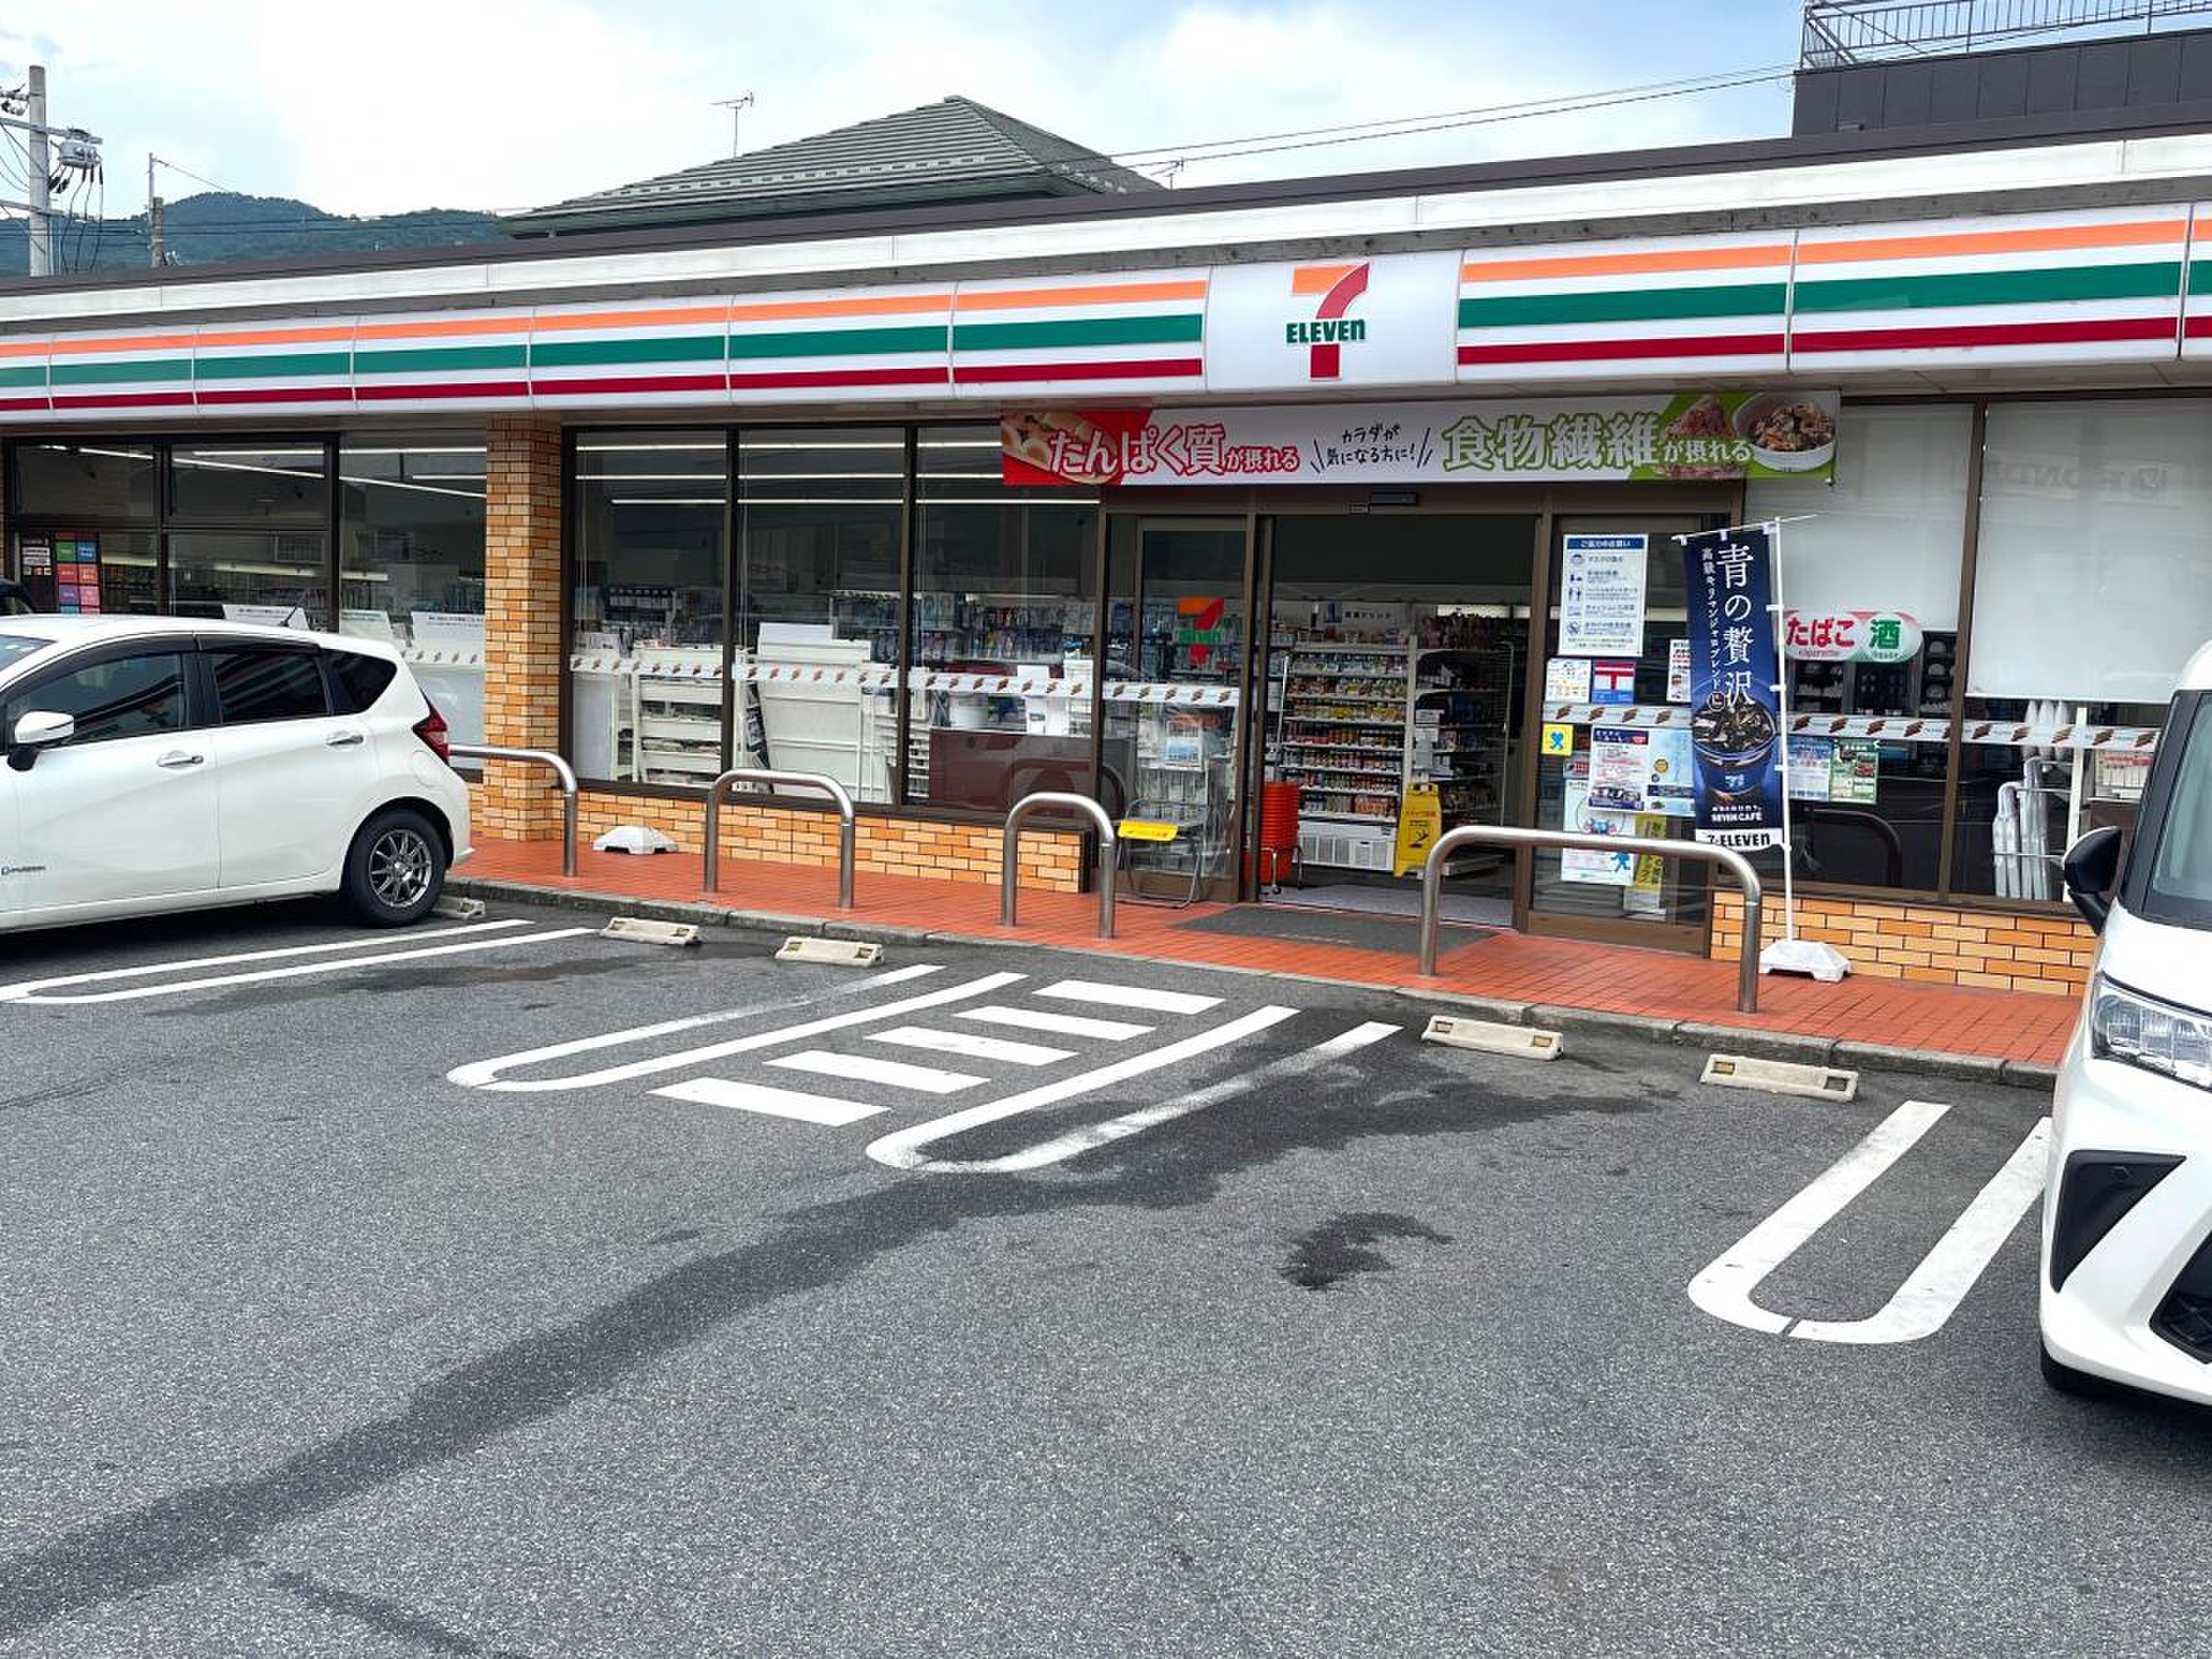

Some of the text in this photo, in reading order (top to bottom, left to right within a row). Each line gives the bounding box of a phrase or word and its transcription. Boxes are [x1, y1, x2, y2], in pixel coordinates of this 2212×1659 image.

[1292, 264, 1371, 379] 7
[1342, 423, 1401, 443] カラダが
[1716, 544, 1756, 708] 青の贅沢
[1786, 618, 1901, 649] たばこ 酒
